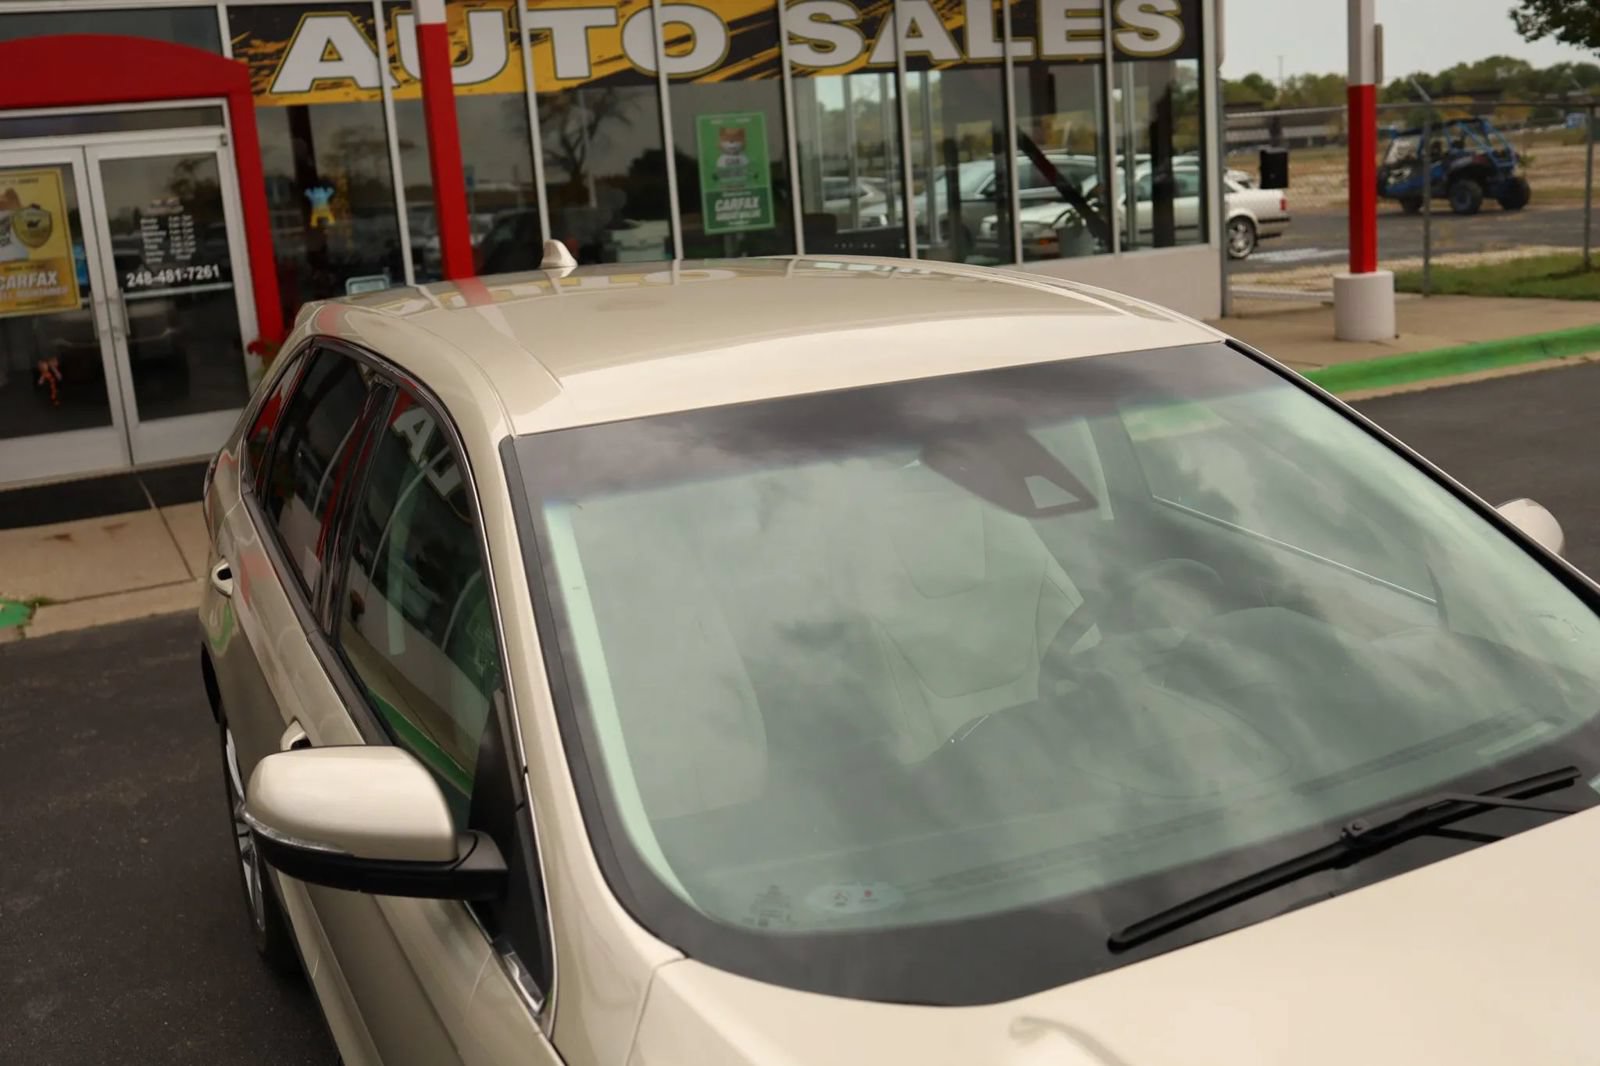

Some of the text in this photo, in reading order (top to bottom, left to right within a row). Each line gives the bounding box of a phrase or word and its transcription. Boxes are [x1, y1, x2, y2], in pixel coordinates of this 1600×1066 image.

[269, 0, 1185, 95] AUTO SALES
[714, 196, 761, 211] CARFAX
[126, 264, 220, 288] 248-481-7261
